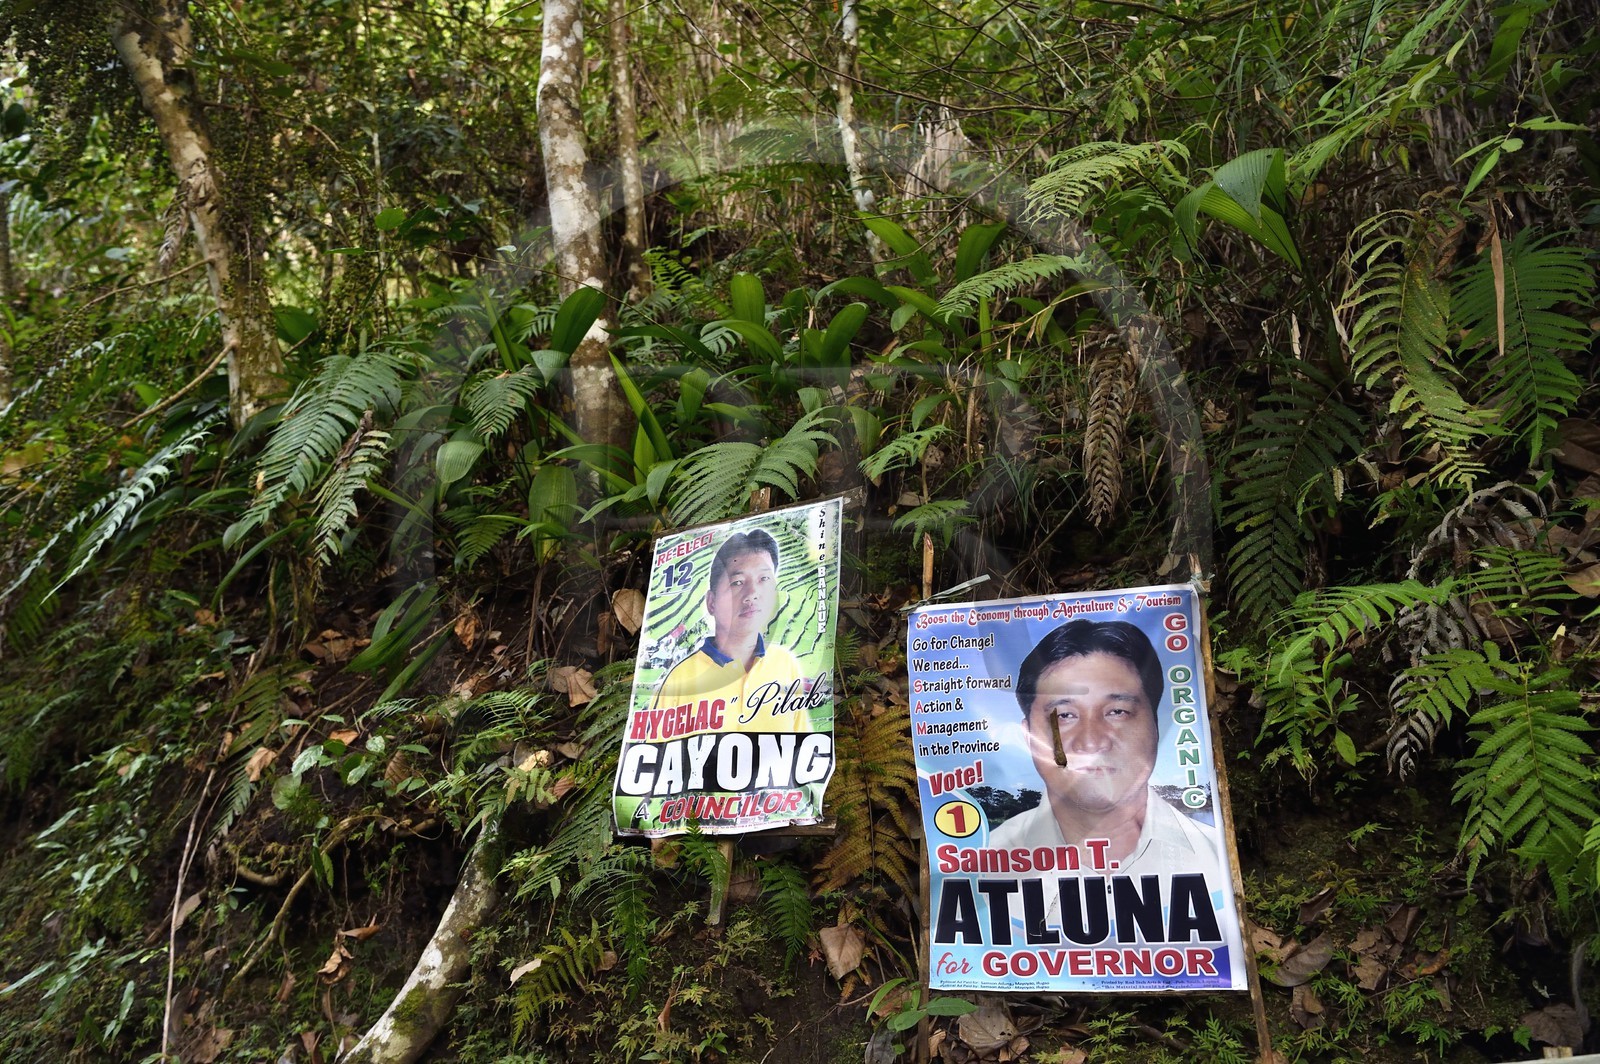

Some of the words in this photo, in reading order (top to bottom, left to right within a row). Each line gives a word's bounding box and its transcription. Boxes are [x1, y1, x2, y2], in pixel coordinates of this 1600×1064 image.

[657, 531, 715, 566] RE-ELECT
[818, 506, 826, 560] Shine
[663, 562, 693, 588] 12
[818, 566, 826, 633] BANAUE
[917, 613, 947, 628] Boost
[952, 611, 965, 622] the
[968, 609, 1010, 626] Economy
[1014, 605, 1049, 620] through
[1053, 600, 1113, 618] Agriculture
[1118, 598, 1132, 612] &
[1136, 595, 1180, 611] Tourism
[913, 638, 927, 651] Go
[931, 637, 947, 649] for
[951, 634, 994, 650] Change!
[1165, 614, 1189, 651] GO
[913, 659, 930, 671] We
[933, 657, 969, 670] need...
[914, 677, 963, 693] Straight
[966, 675, 1011, 689] forward
[630, 699, 725, 740] HYGELAC
[915, 700, 952, 713] Action
[955, 698, 963, 711] &
[917, 719, 988, 736] Management
[1169, 667, 1206, 808] ORGANIC
[619, 733, 832, 796] CAYONG
[919, 744, 928, 756] in
[931, 743, 949, 755] the
[952, 740, 999, 754] Province
[929, 760, 982, 796] Vote!
[636, 803, 650, 820] 4
[660, 791, 802, 823] COUNCILOR
[946, 805, 967, 834] 1
[937, 844, 1079, 873] Samson
[1086, 839, 1119, 870] T.
[934, 873, 1222, 945] ATLUNA
[937, 952, 973, 977] for
[982, 949, 1217, 976] GOVERNOR
